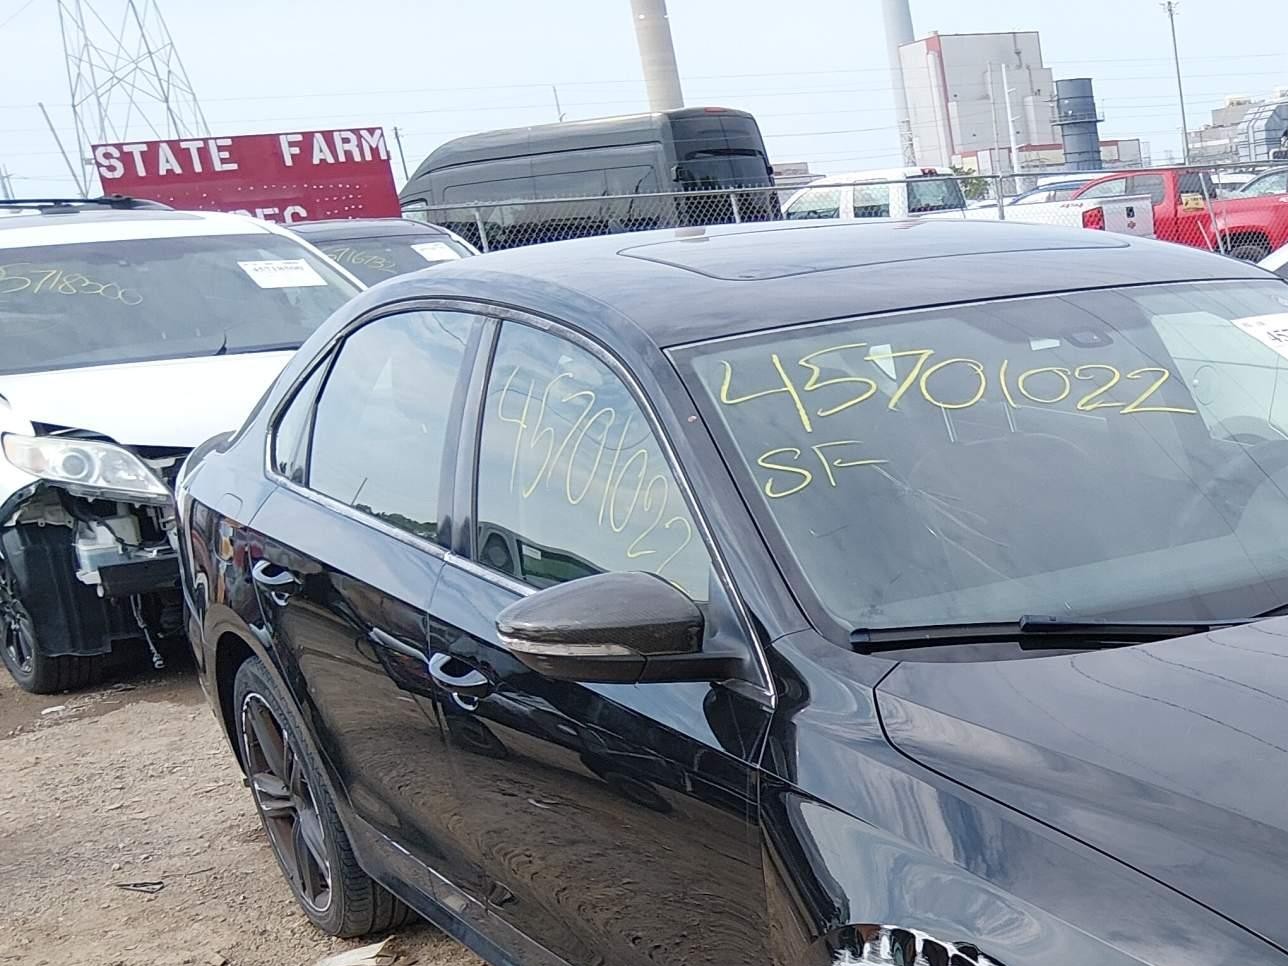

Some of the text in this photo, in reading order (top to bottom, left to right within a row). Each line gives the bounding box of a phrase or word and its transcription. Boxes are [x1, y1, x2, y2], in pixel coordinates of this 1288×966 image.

[94, 129, 390, 179] STATE FARM
[719, 342, 1198, 433] 45701022
[757, 440, 890, 498] SF
